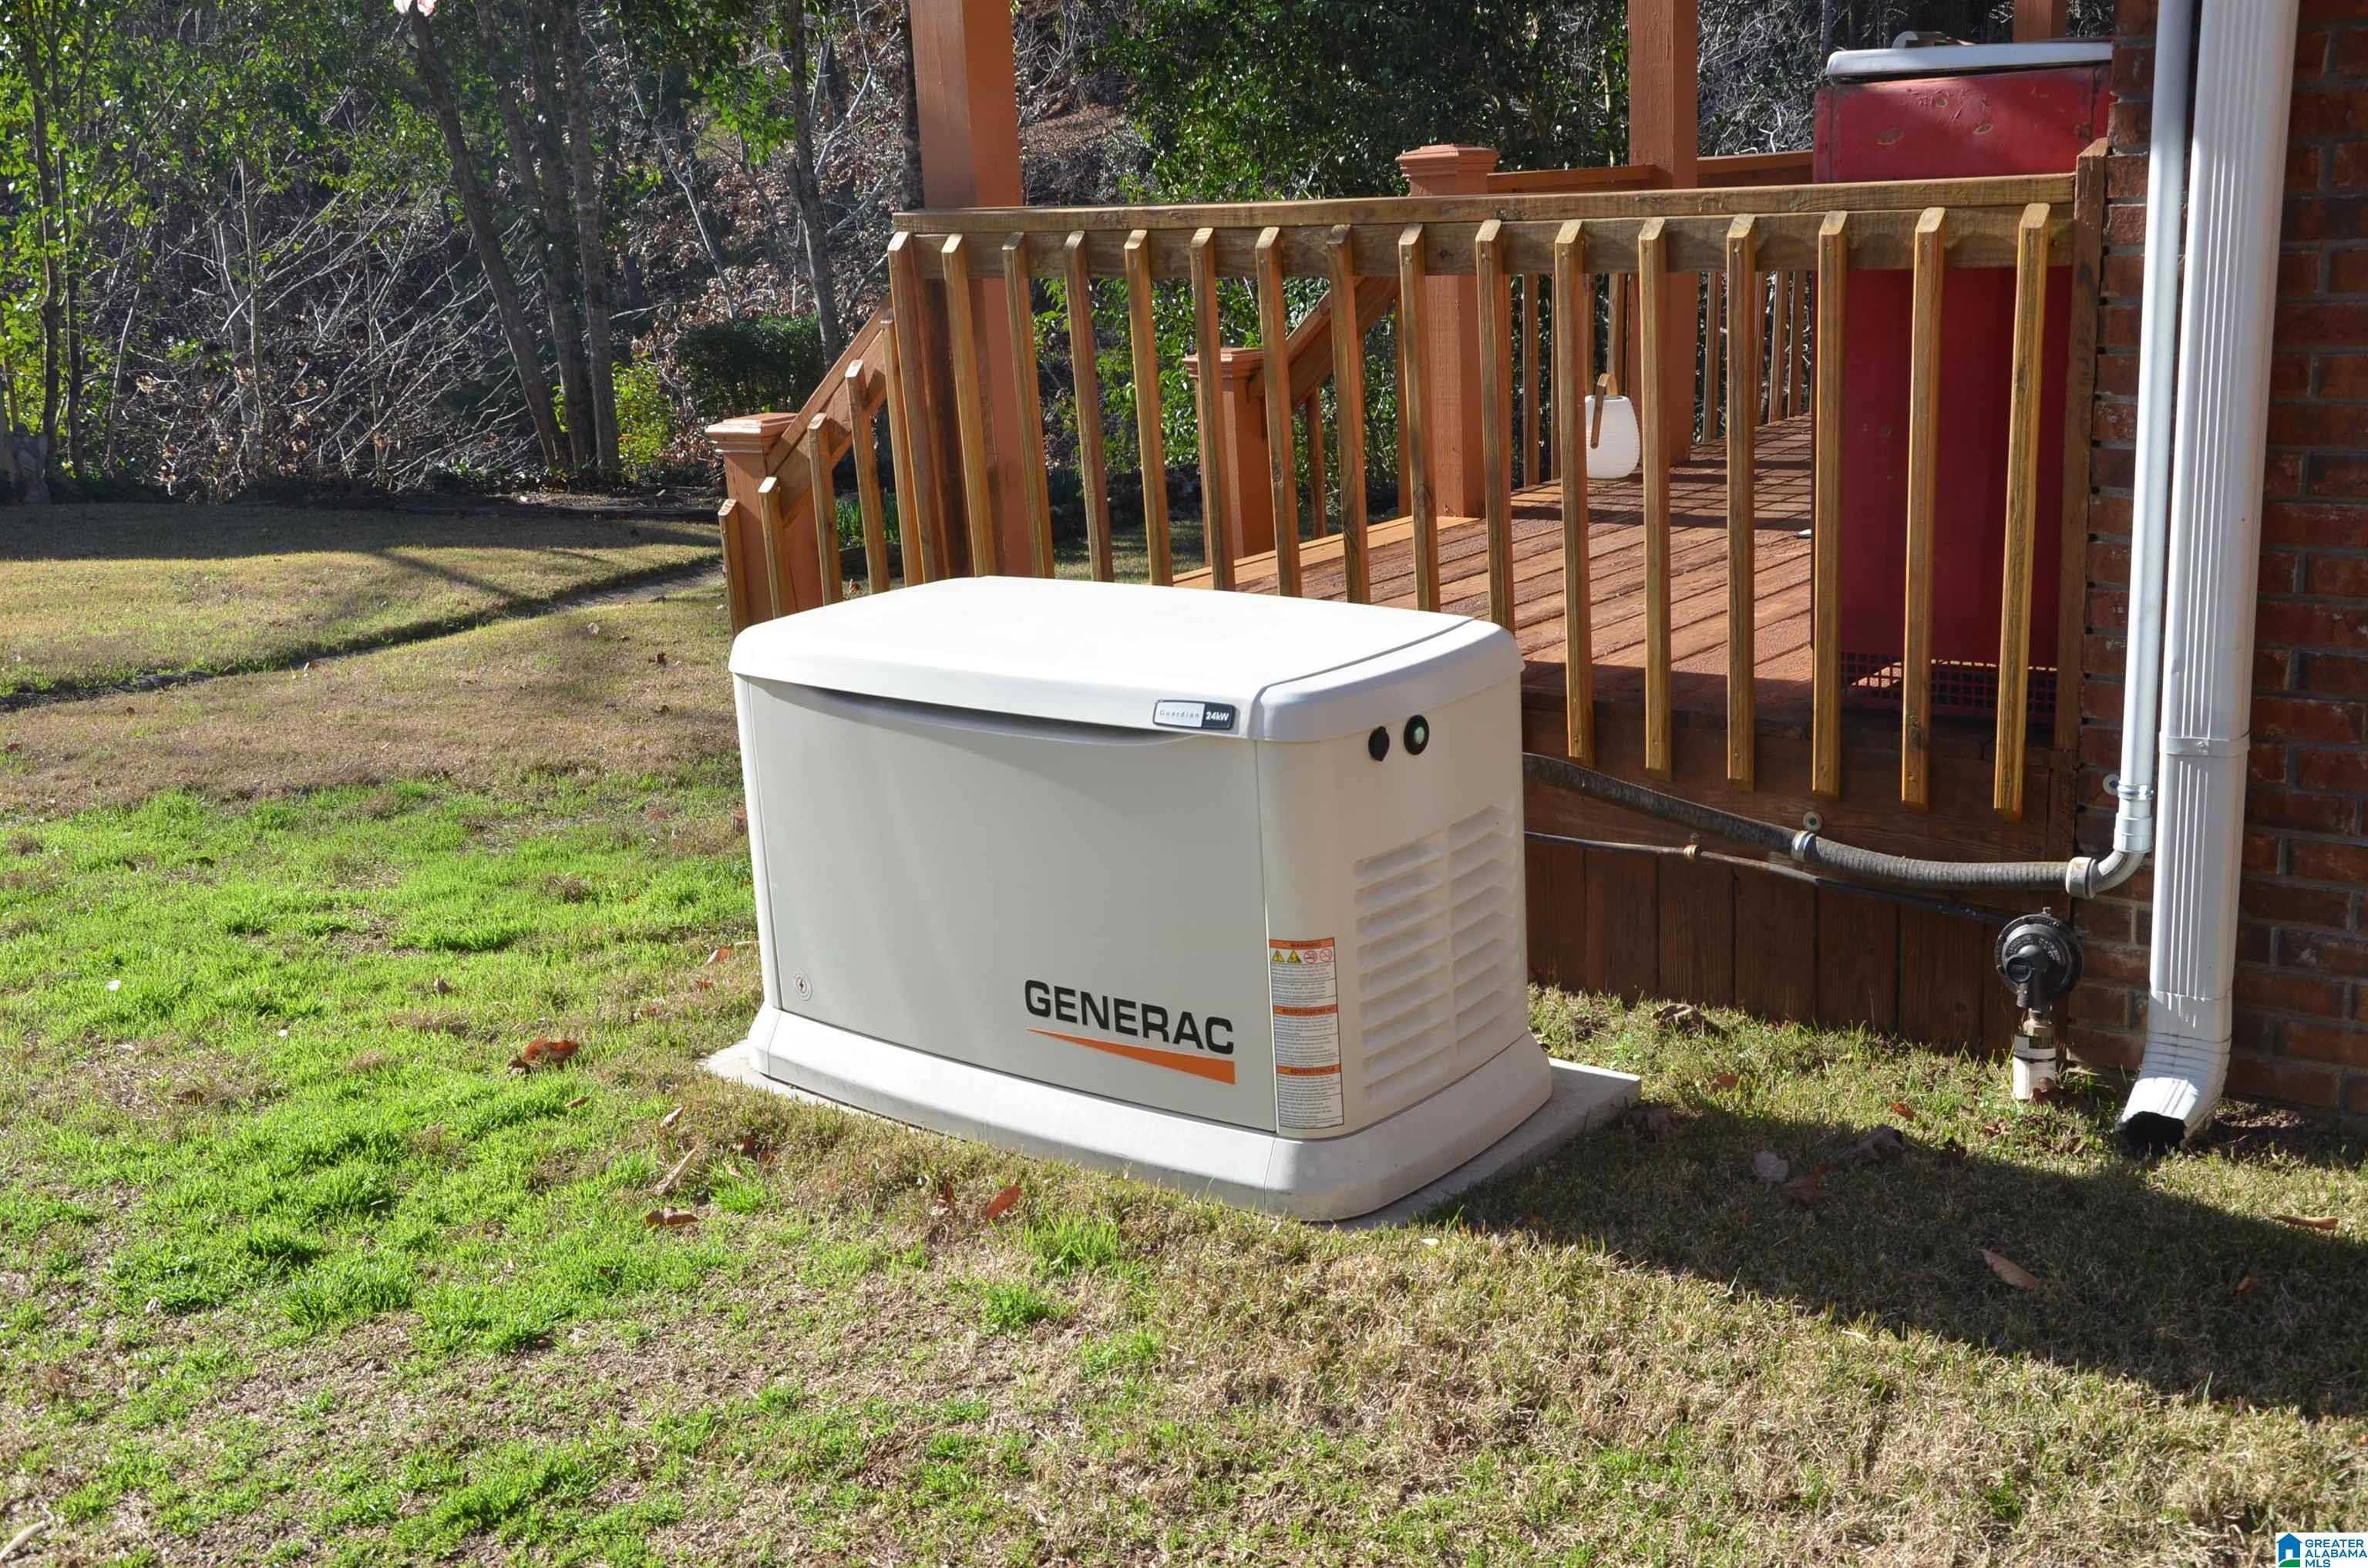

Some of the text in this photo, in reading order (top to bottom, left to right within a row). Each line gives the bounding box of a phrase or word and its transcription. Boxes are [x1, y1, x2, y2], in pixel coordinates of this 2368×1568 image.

[1159, 708, 1230, 722] Guardian 24kW
[1024, 980, 1234, 1055] GENERAC
